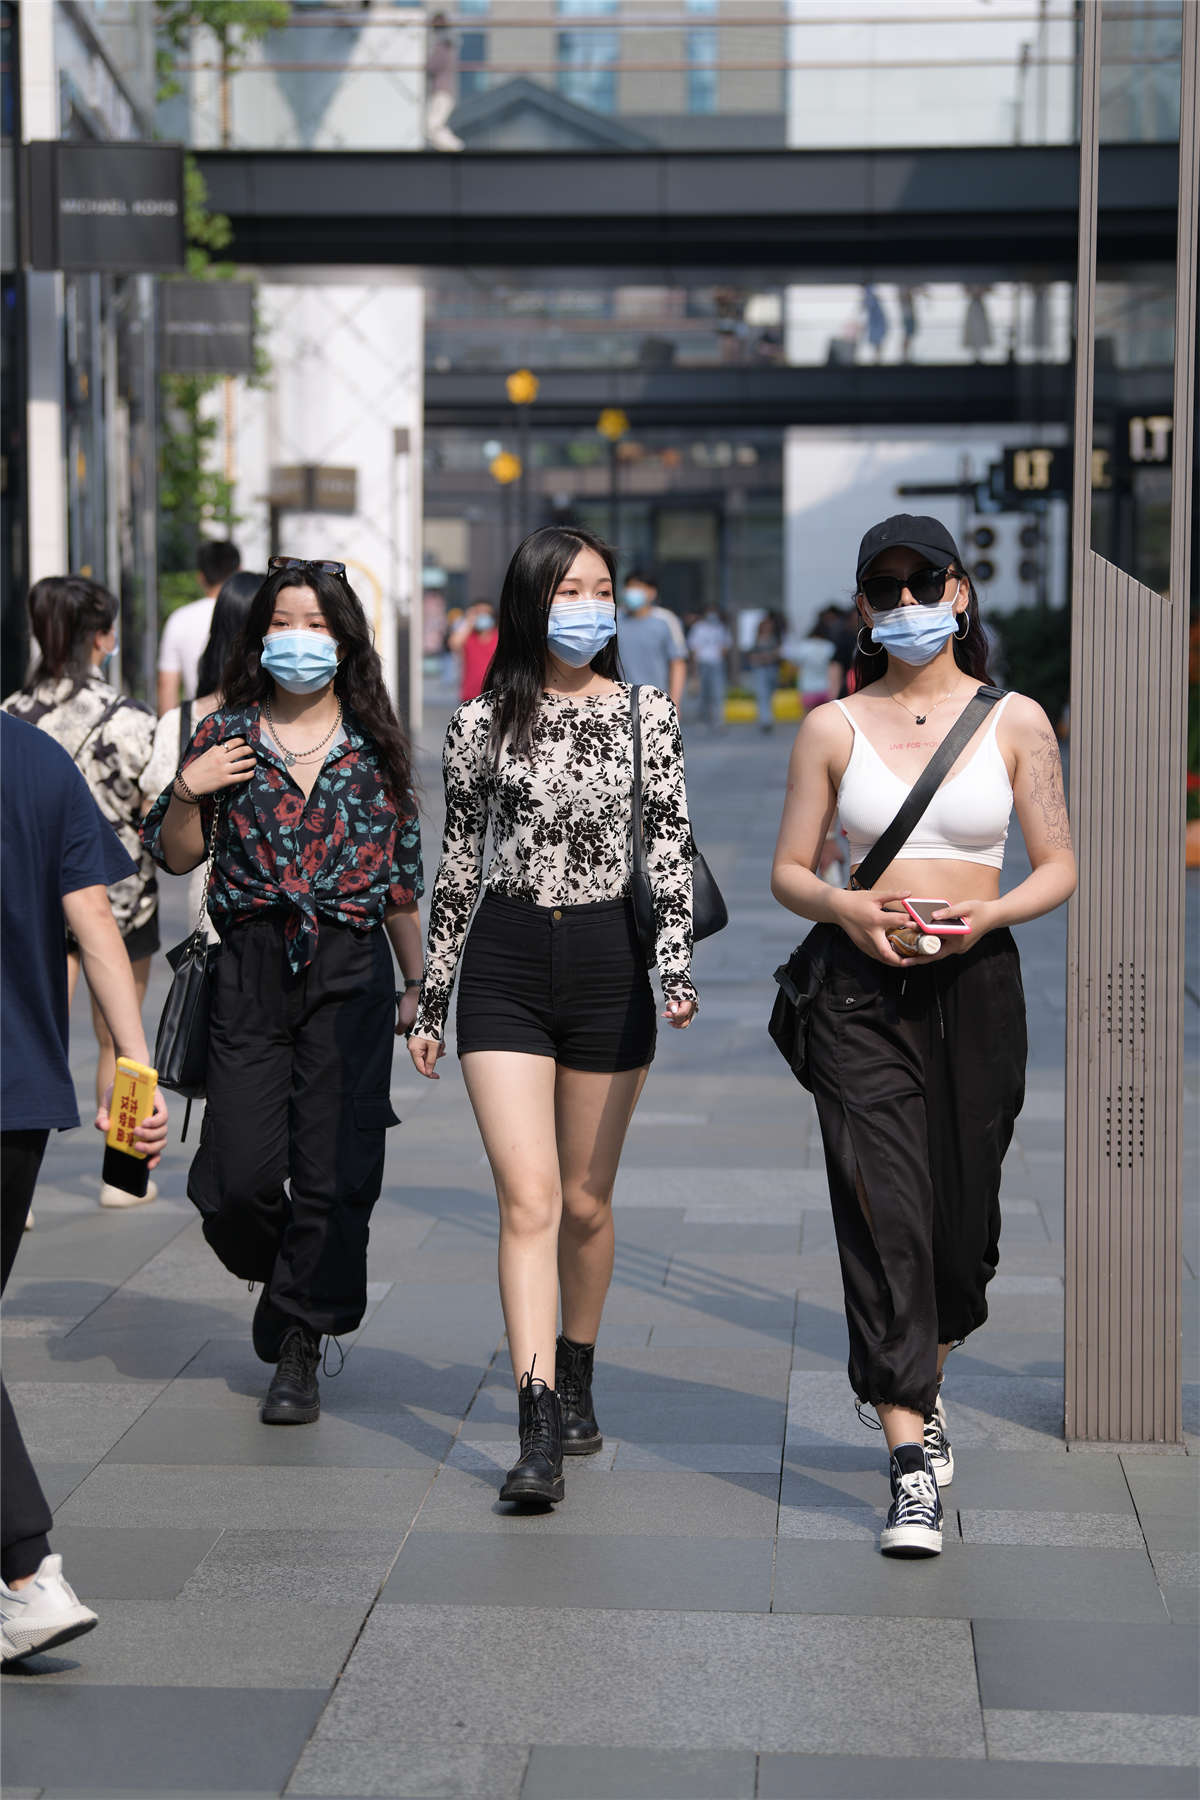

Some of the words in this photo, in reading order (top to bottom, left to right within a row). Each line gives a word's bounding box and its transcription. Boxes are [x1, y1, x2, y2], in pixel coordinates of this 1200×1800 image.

[60, 199, 127, 216] MICHAEL
[133, 199, 178, 216] KORS
[906, 741, 920, 749] FOR
